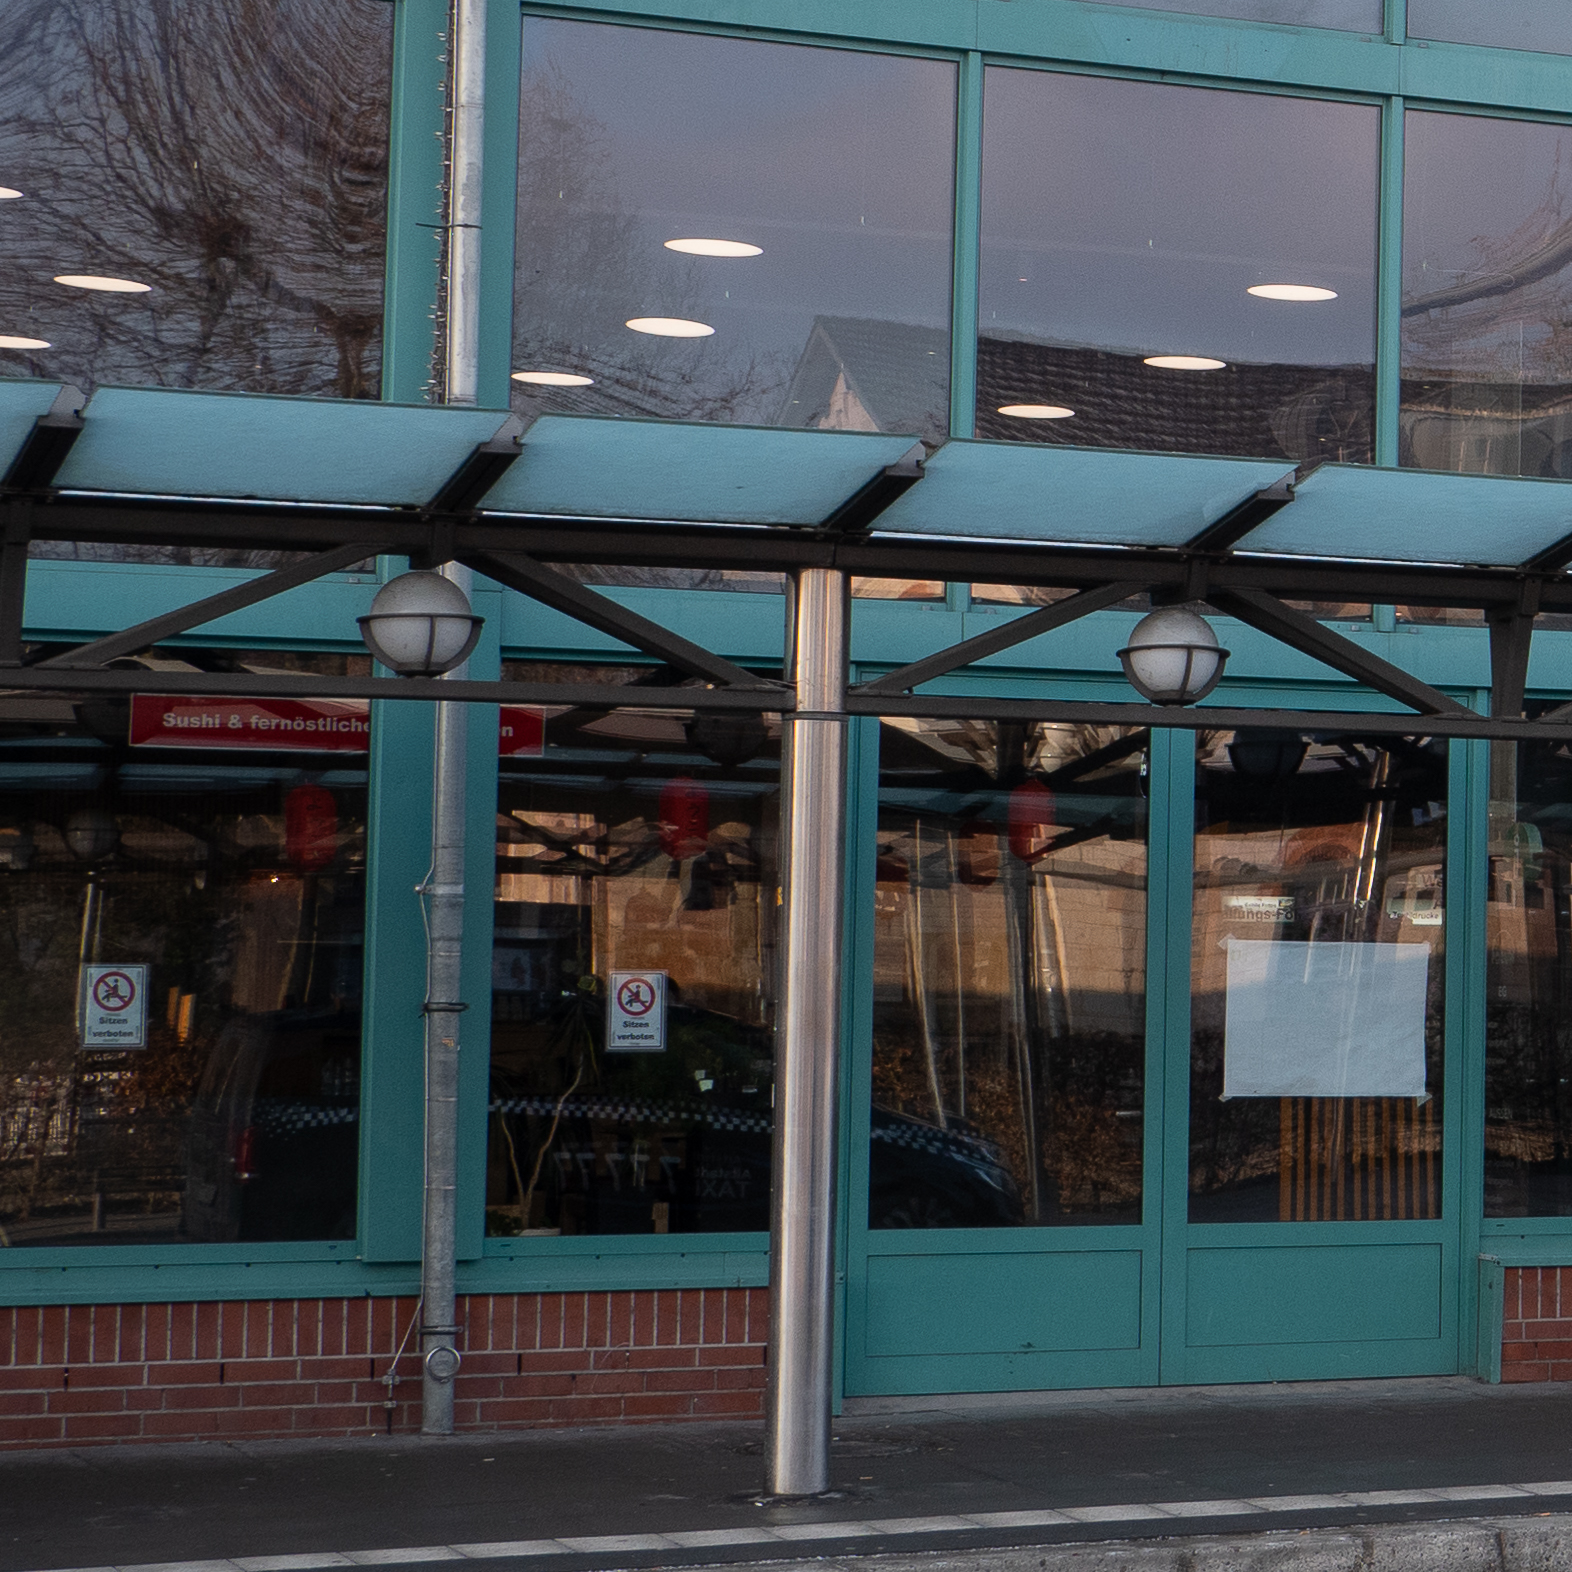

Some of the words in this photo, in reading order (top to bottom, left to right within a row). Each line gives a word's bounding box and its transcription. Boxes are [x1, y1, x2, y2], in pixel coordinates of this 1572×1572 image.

[162, 712, 220, 729] Sushi
[227, 713, 243, 729] &
[99, 1016, 128, 1025] Sitzen
[622, 1020, 650, 1028] Sitzen
[92, 1029, 134, 1038] verboten
[616, 1032, 655, 1040] verboten
